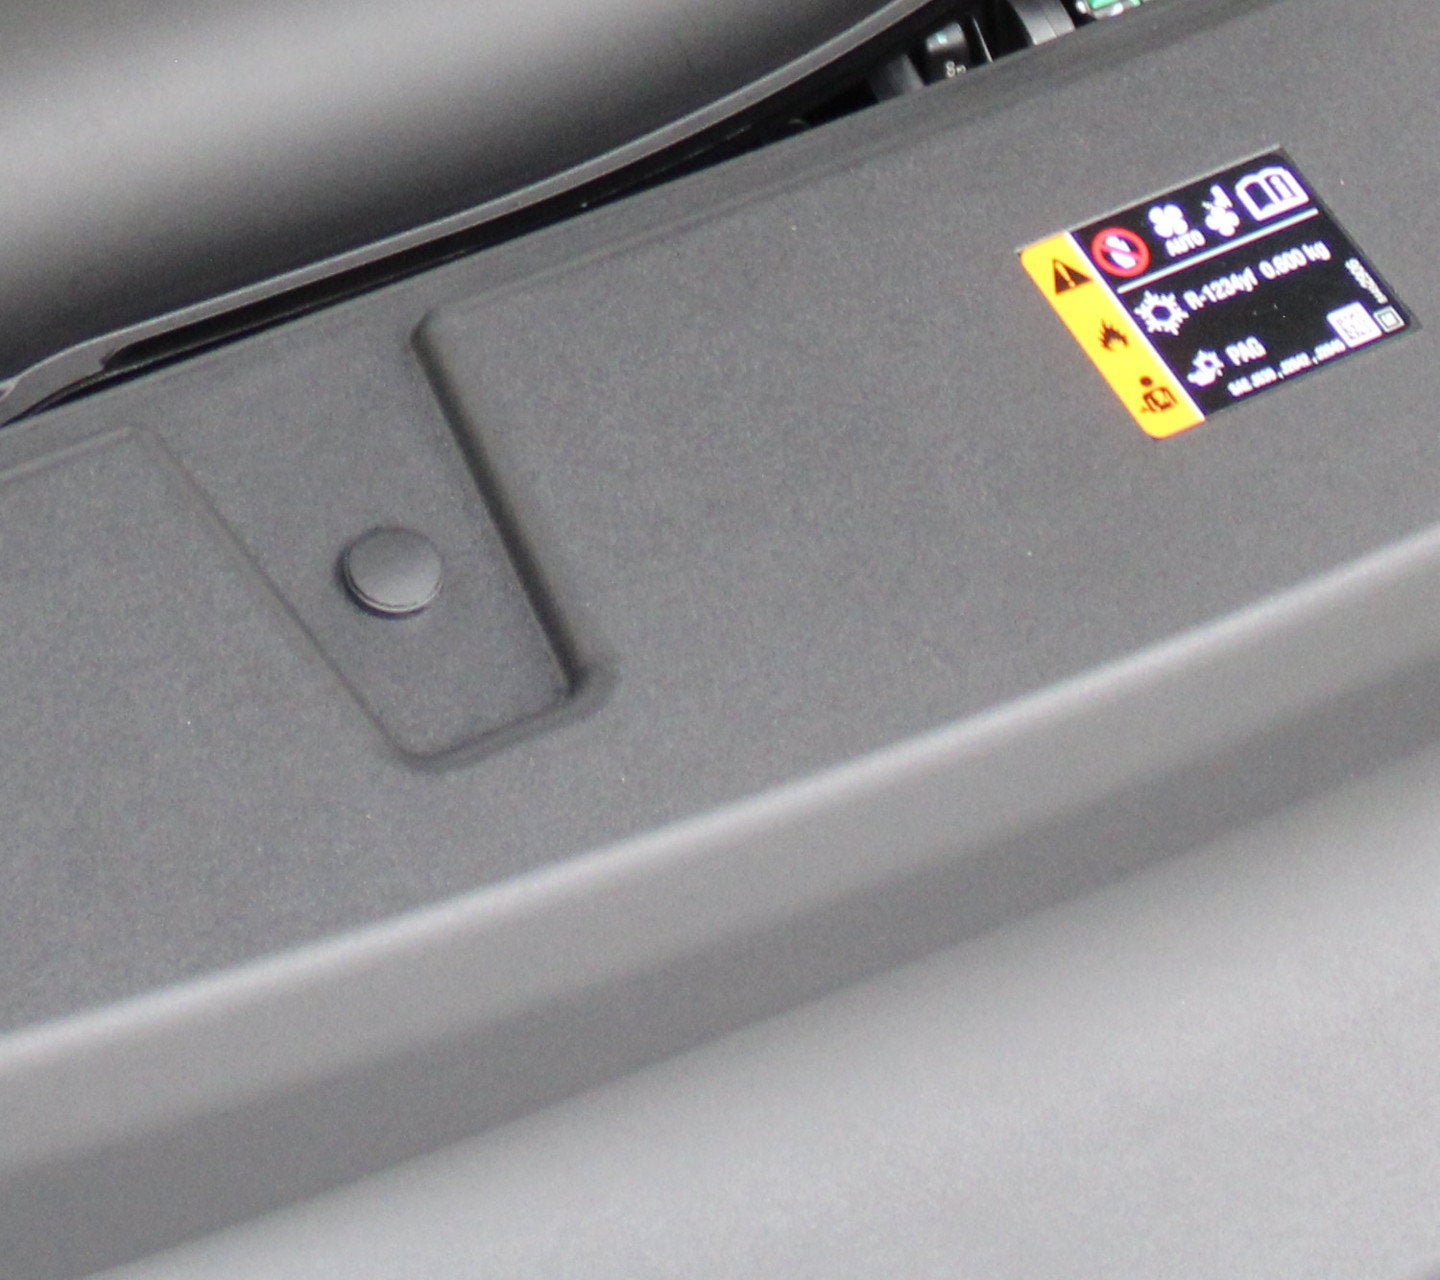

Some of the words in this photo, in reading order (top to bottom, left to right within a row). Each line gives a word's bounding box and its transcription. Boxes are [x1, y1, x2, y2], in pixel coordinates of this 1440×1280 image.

[1165, 229, 1206, 257] AUTO
[1301, 240, 1332, 262] kg
[1224, 336, 1267, 366] PAG
